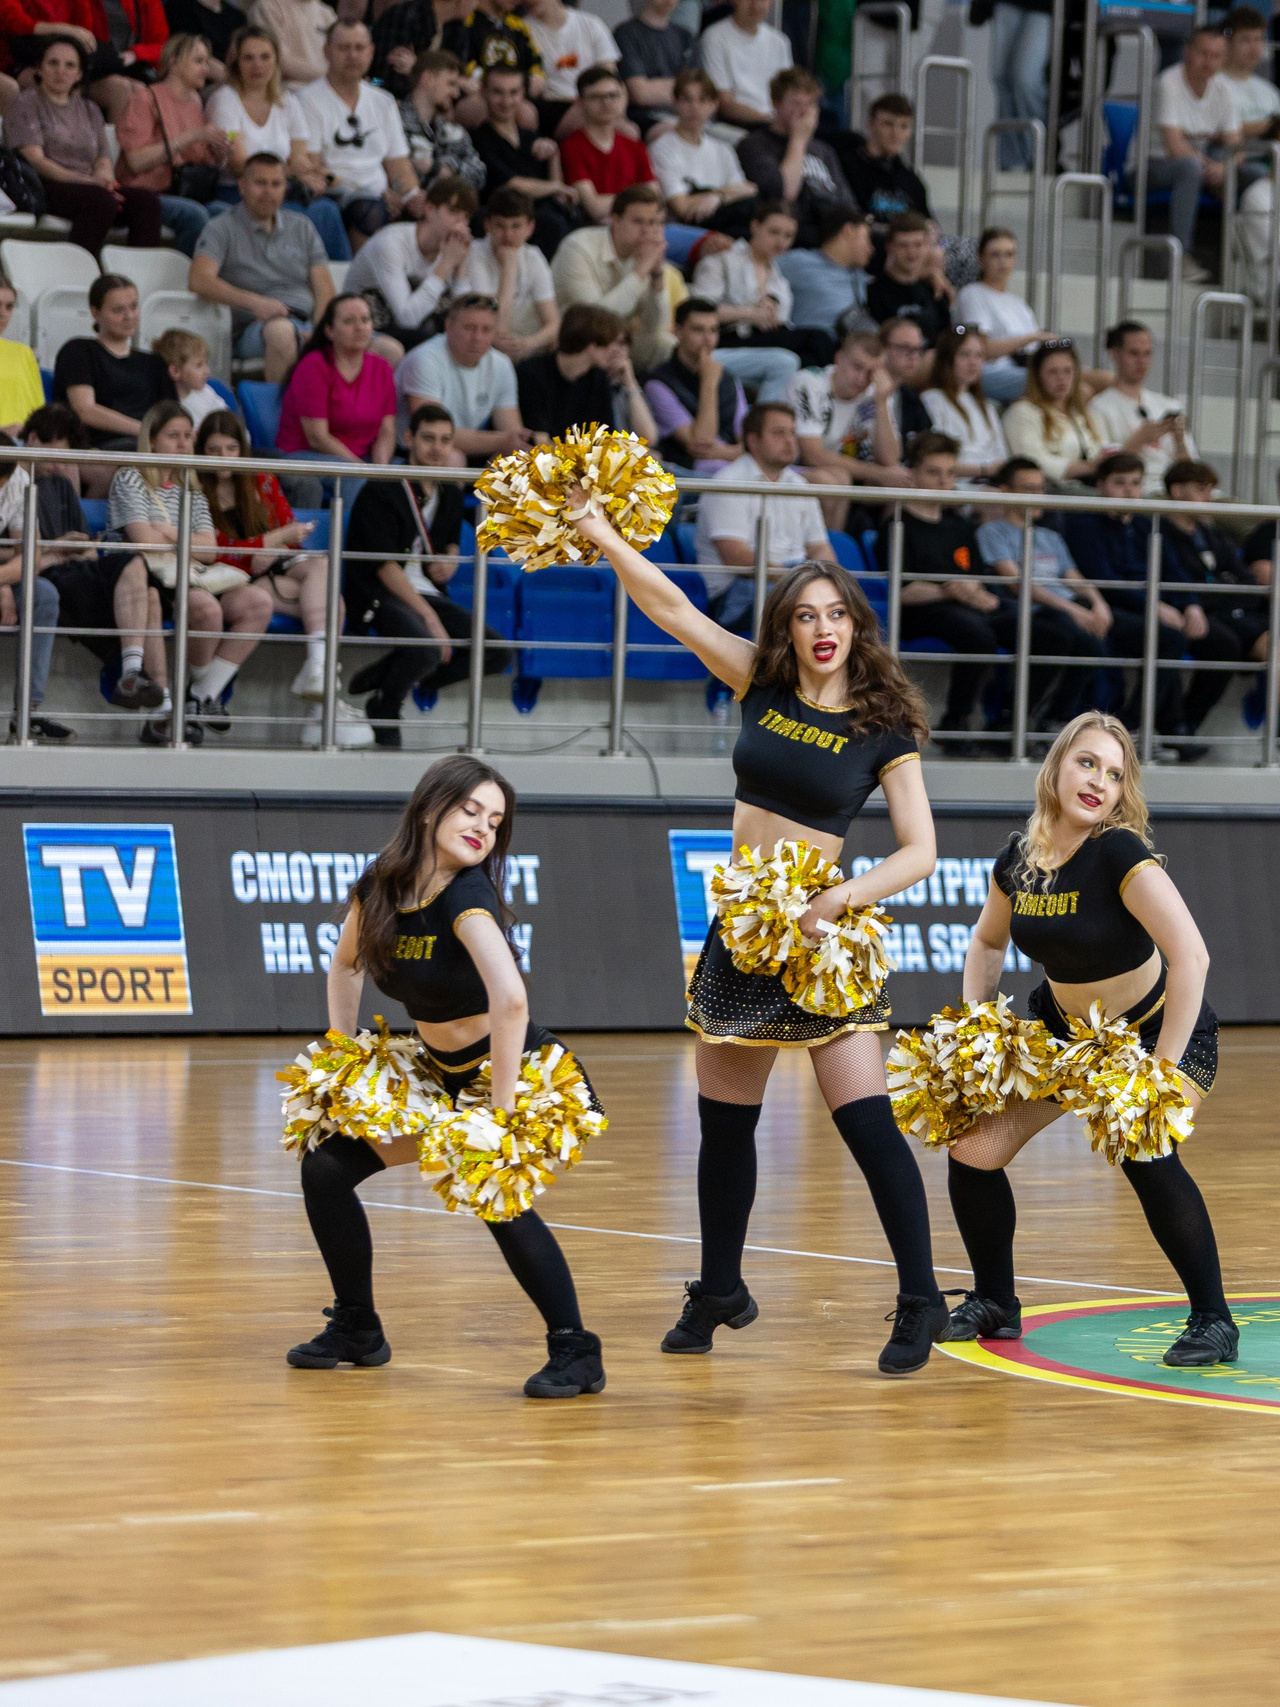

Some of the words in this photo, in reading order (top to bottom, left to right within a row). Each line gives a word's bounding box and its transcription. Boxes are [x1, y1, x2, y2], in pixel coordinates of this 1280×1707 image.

[758, 708, 849, 754] TIMEOUT
[40, 845, 158, 929] TV
[1013, 890, 1080, 917] TIMEOUT
[395, 935, 438, 960] EOUT
[52, 966, 175, 1004] SPORT
